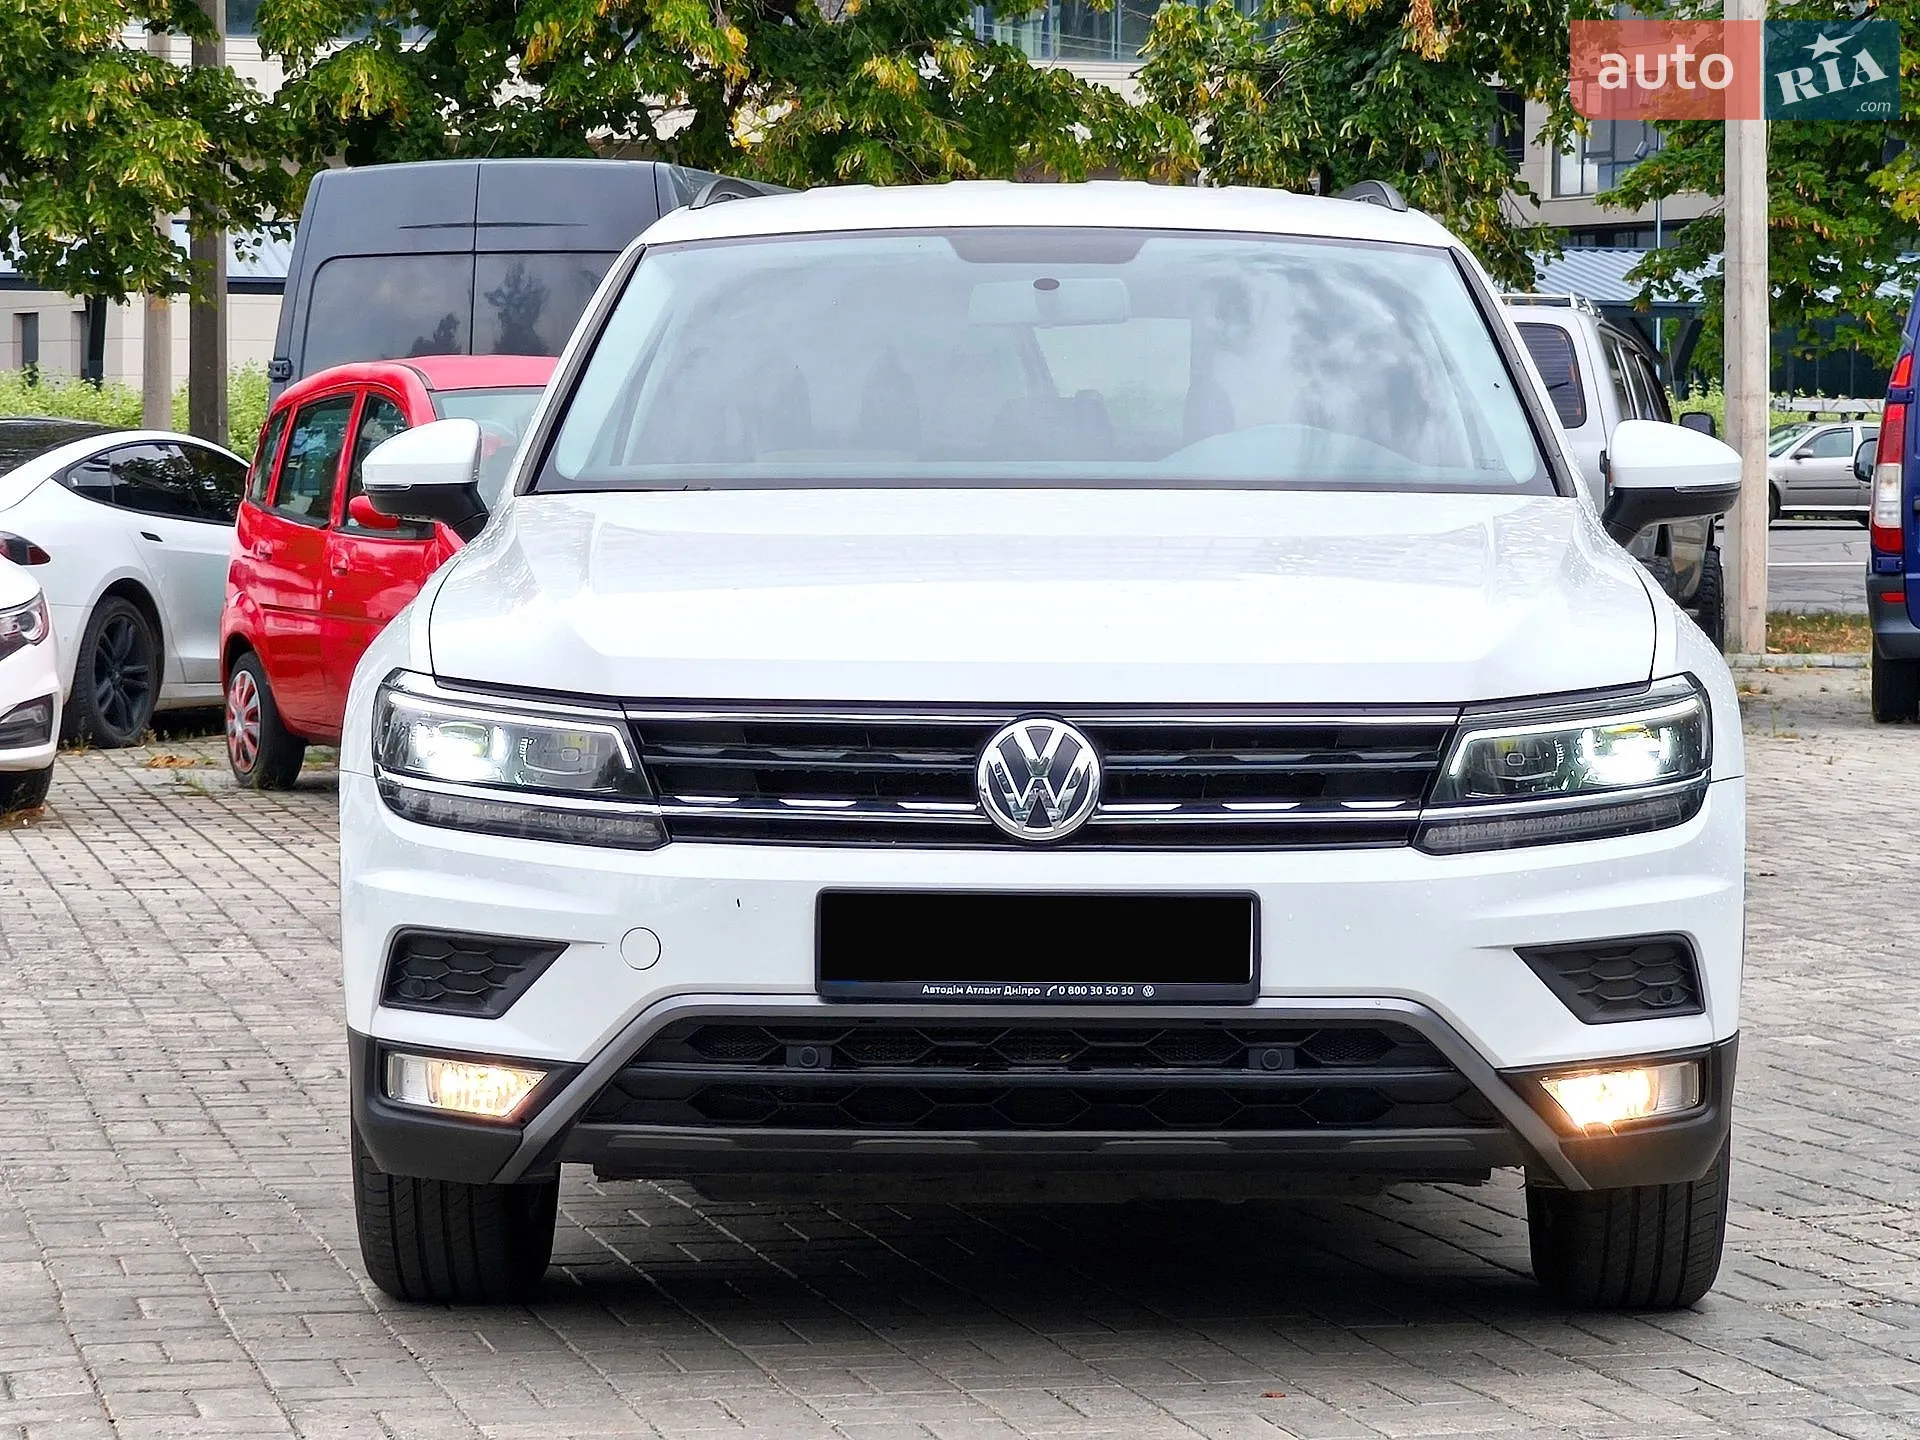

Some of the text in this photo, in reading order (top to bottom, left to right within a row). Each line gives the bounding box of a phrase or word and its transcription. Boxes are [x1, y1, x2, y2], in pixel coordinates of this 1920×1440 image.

[965, 985, 1002, 995] Атлант
[1003, 986, 1041, 997] Дніпро
[1058, 986, 1066, 995] 0
[1067, 986, 1088, 995] 800
[1090, 986, 1103, 995] 30
[1105, 986, 1119, 996] 50
[1121, 986, 1134, 996] 30
